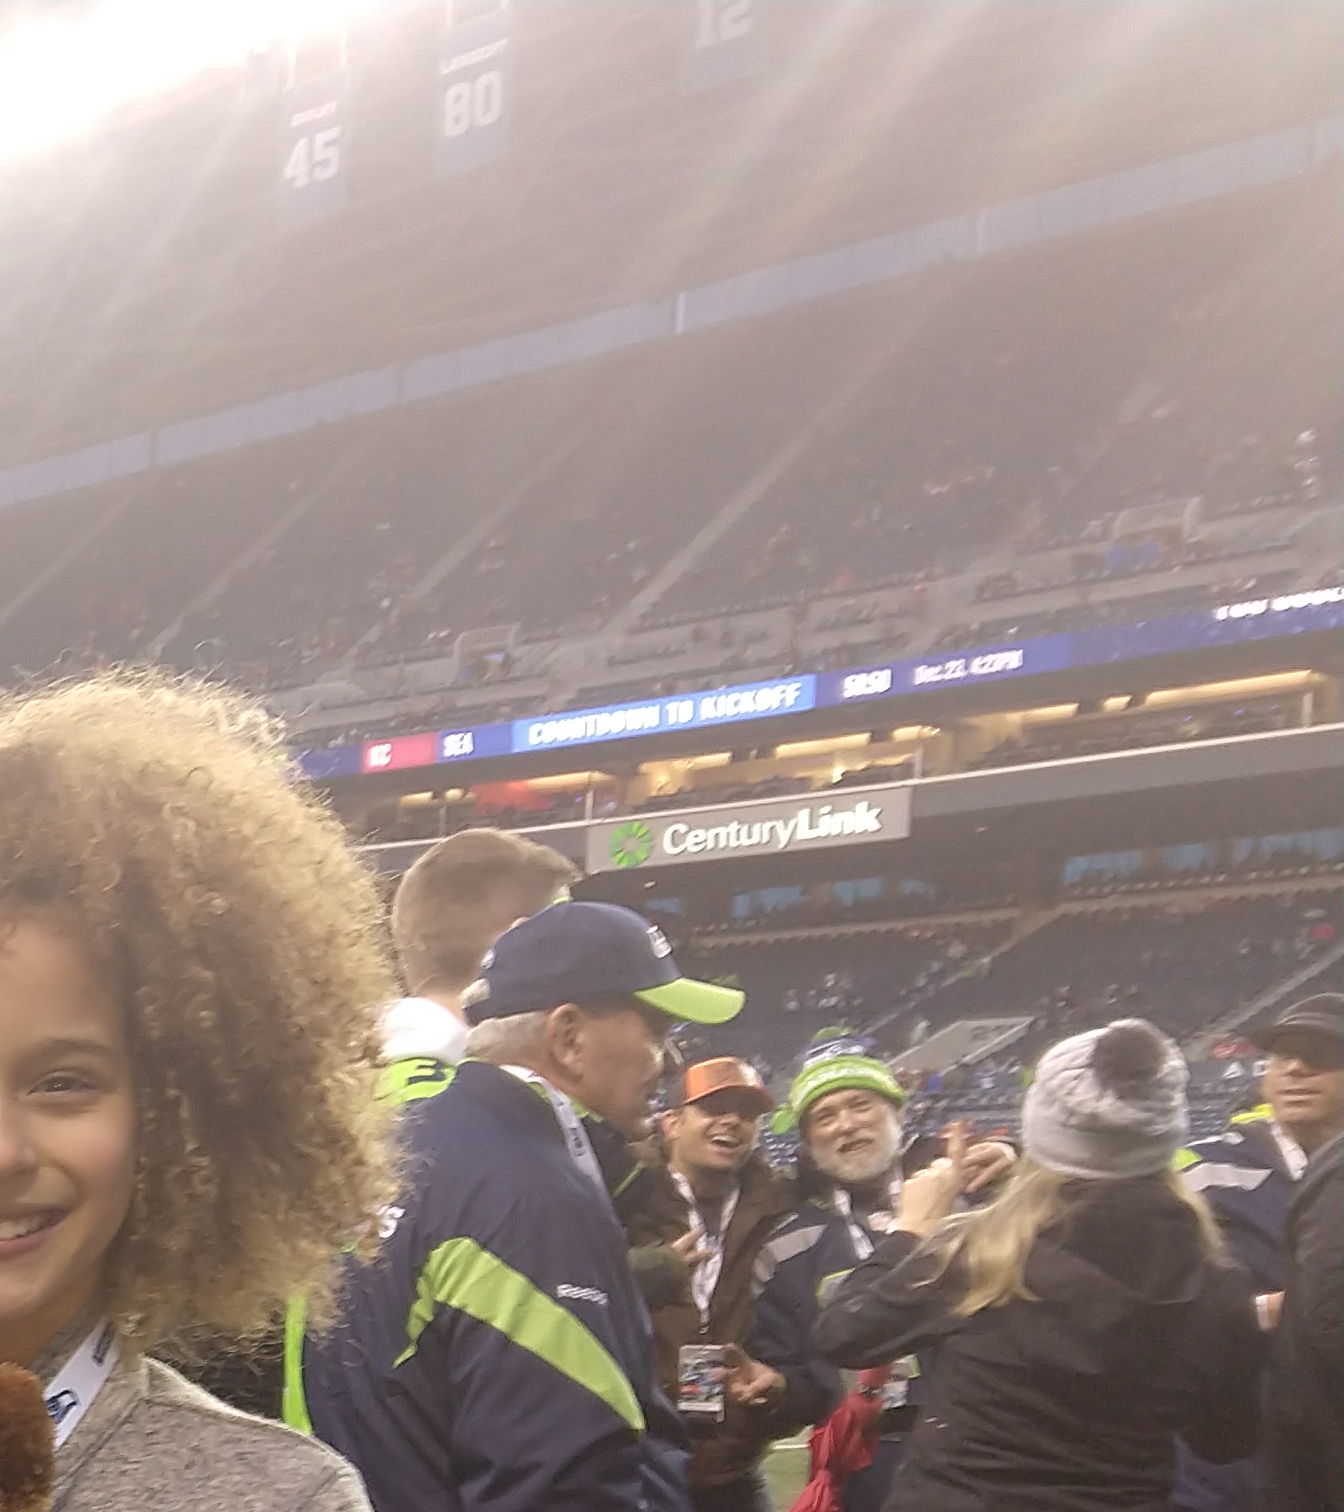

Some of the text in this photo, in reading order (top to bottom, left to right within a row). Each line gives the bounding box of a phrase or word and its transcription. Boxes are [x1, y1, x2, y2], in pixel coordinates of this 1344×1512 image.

[444, 70, 502, 137] 80
[283, 126, 342, 189] 45
[528, 705, 660, 745] COUNTDOWN
[665, 699, 694, 725] TO
[699, 682, 802, 721] KICKOFF
[662, 800, 883, 855] CenturyLink
